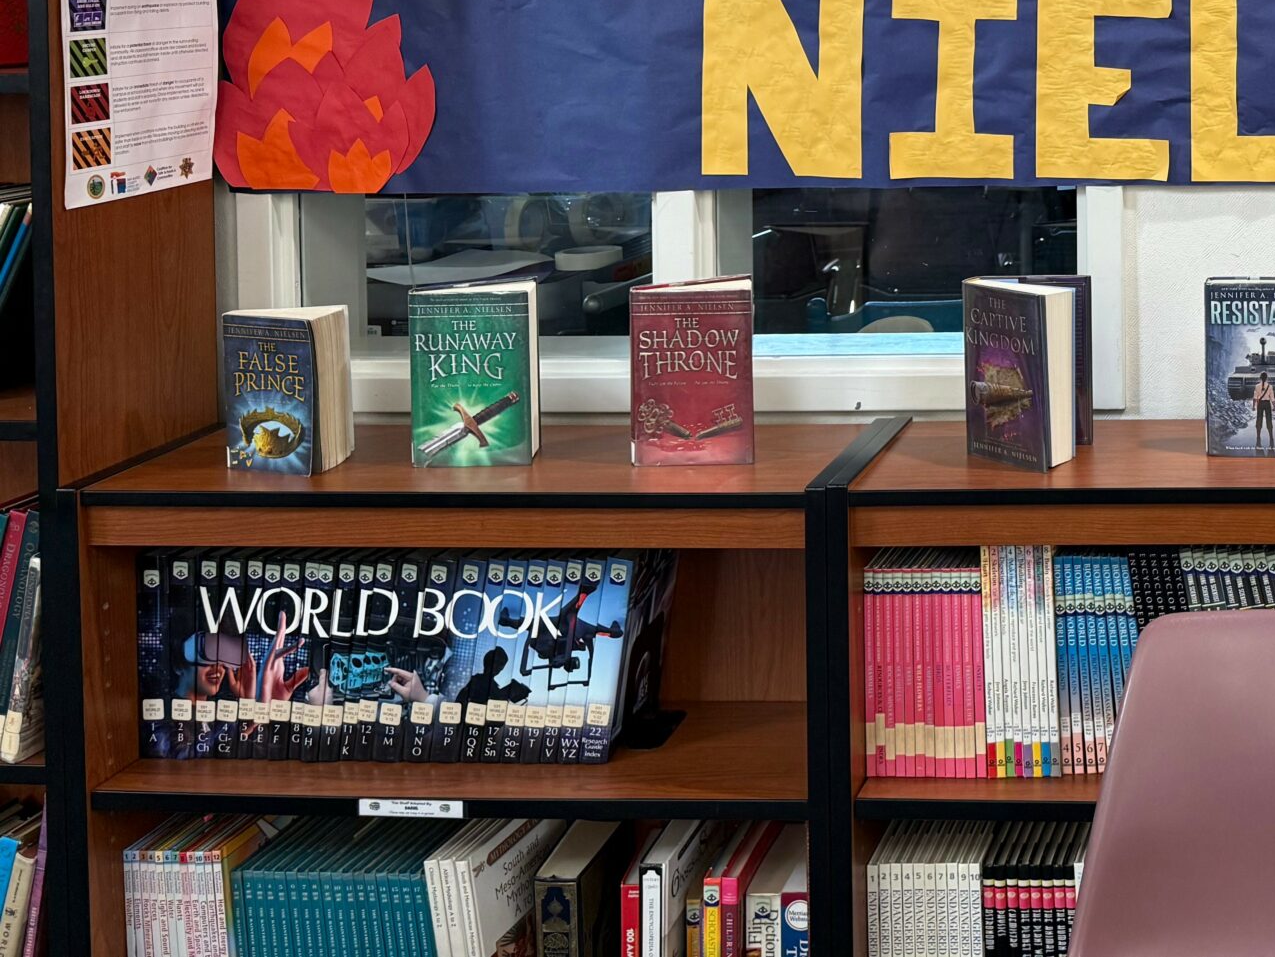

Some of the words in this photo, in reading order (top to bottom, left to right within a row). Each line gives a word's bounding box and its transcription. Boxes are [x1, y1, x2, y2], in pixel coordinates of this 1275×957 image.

[640, 304, 682, 312] JENNIFER
[988, 297, 1006, 309] THE
[417, 306, 460, 315] JENNIFER
[452, 320, 477, 330] THE
[674, 318, 699, 328] THE
[970, 309, 1027, 333] CAPTIVE
[228, 326, 264, 336] JENNIFER
[274, 330, 305, 339] NIELSEN
[414, 332, 516, 351] RUNAWAY
[639, 329, 739, 349] SHADOW
[965, 326, 1035, 355] KINGDOM
[258, 341, 277, 352] THE
[238, 351, 299, 374] FALSE
[428, 353, 503, 382] KING
[639, 351, 737, 380] THRONE
[233, 372, 305, 401] PRINCE
[973, 442, 1002, 454] JENNIFER
[1012, 451, 1037, 463] NIELSEN
[1064, 564, 1073, 594] BIOMES
[1093, 564, 1102, 595] BIOMES
[199, 586, 399, 639] WORLD
[412, 587, 563, 640] BOOK
[361, 725, 371, 733] 12
[444, 727, 453, 735] 15
[469, 727, 479, 736] 16
[488, 727, 499, 735] 17
[508, 728, 520, 736] 18
[528, 728, 539, 737] 19
[546, 727, 558, 736] 20
[566, 728, 576, 736] 21
[590, 727, 601, 736] 22
[218, 734, 232, 742] Ci-
[504, 738, 519, 747] So-
[562, 739, 579, 747] WX
[196, 743, 209, 752] Ch
[218, 744, 231, 753] Cz
[484, 747, 496, 757] Sn
[505, 748, 516, 757] Sz
[562, 749, 576, 758] YZ
[881, 889, 890, 954] ENDANGERED
[893, 890, 902, 955] ENDANGERED
[904, 890, 913, 954] ENDANGERED
[915, 889, 925, 954] ENDANGERED
[926, 889, 936, 954] ENDANGERED
[937, 890, 947, 955] ENDANGERED
[949, 889, 958, 954] ENDANGERED
[960, 890, 970, 955] ENDANGERED
[972, 890, 981, 955] ENDANGERED
